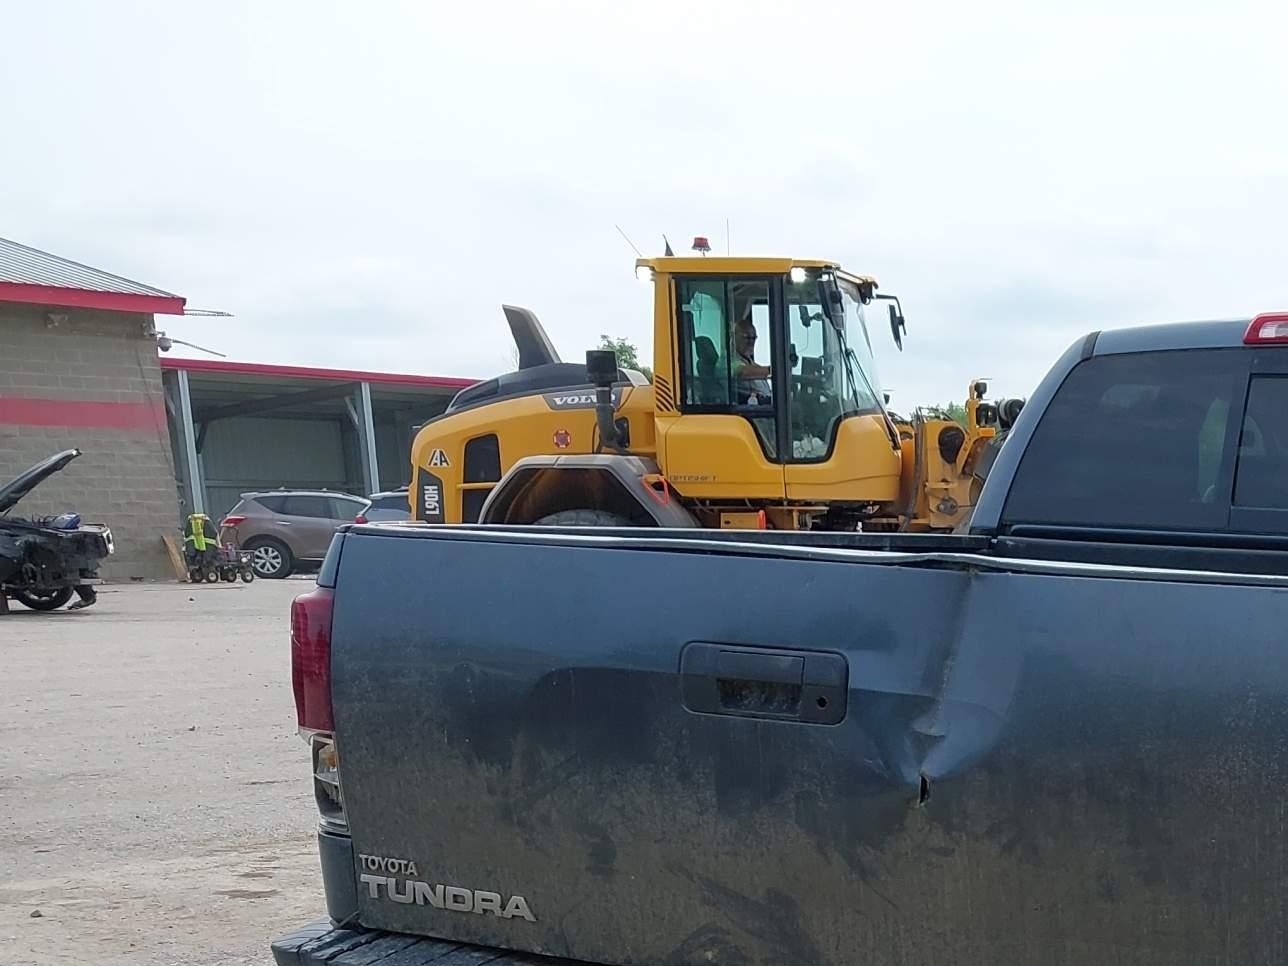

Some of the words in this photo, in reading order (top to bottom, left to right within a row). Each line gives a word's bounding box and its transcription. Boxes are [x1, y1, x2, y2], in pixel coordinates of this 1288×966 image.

[423, 485, 440, 515] L90H
[358, 854, 418, 877] TOYOTA
[360, 874, 537, 922] TUNDRA
